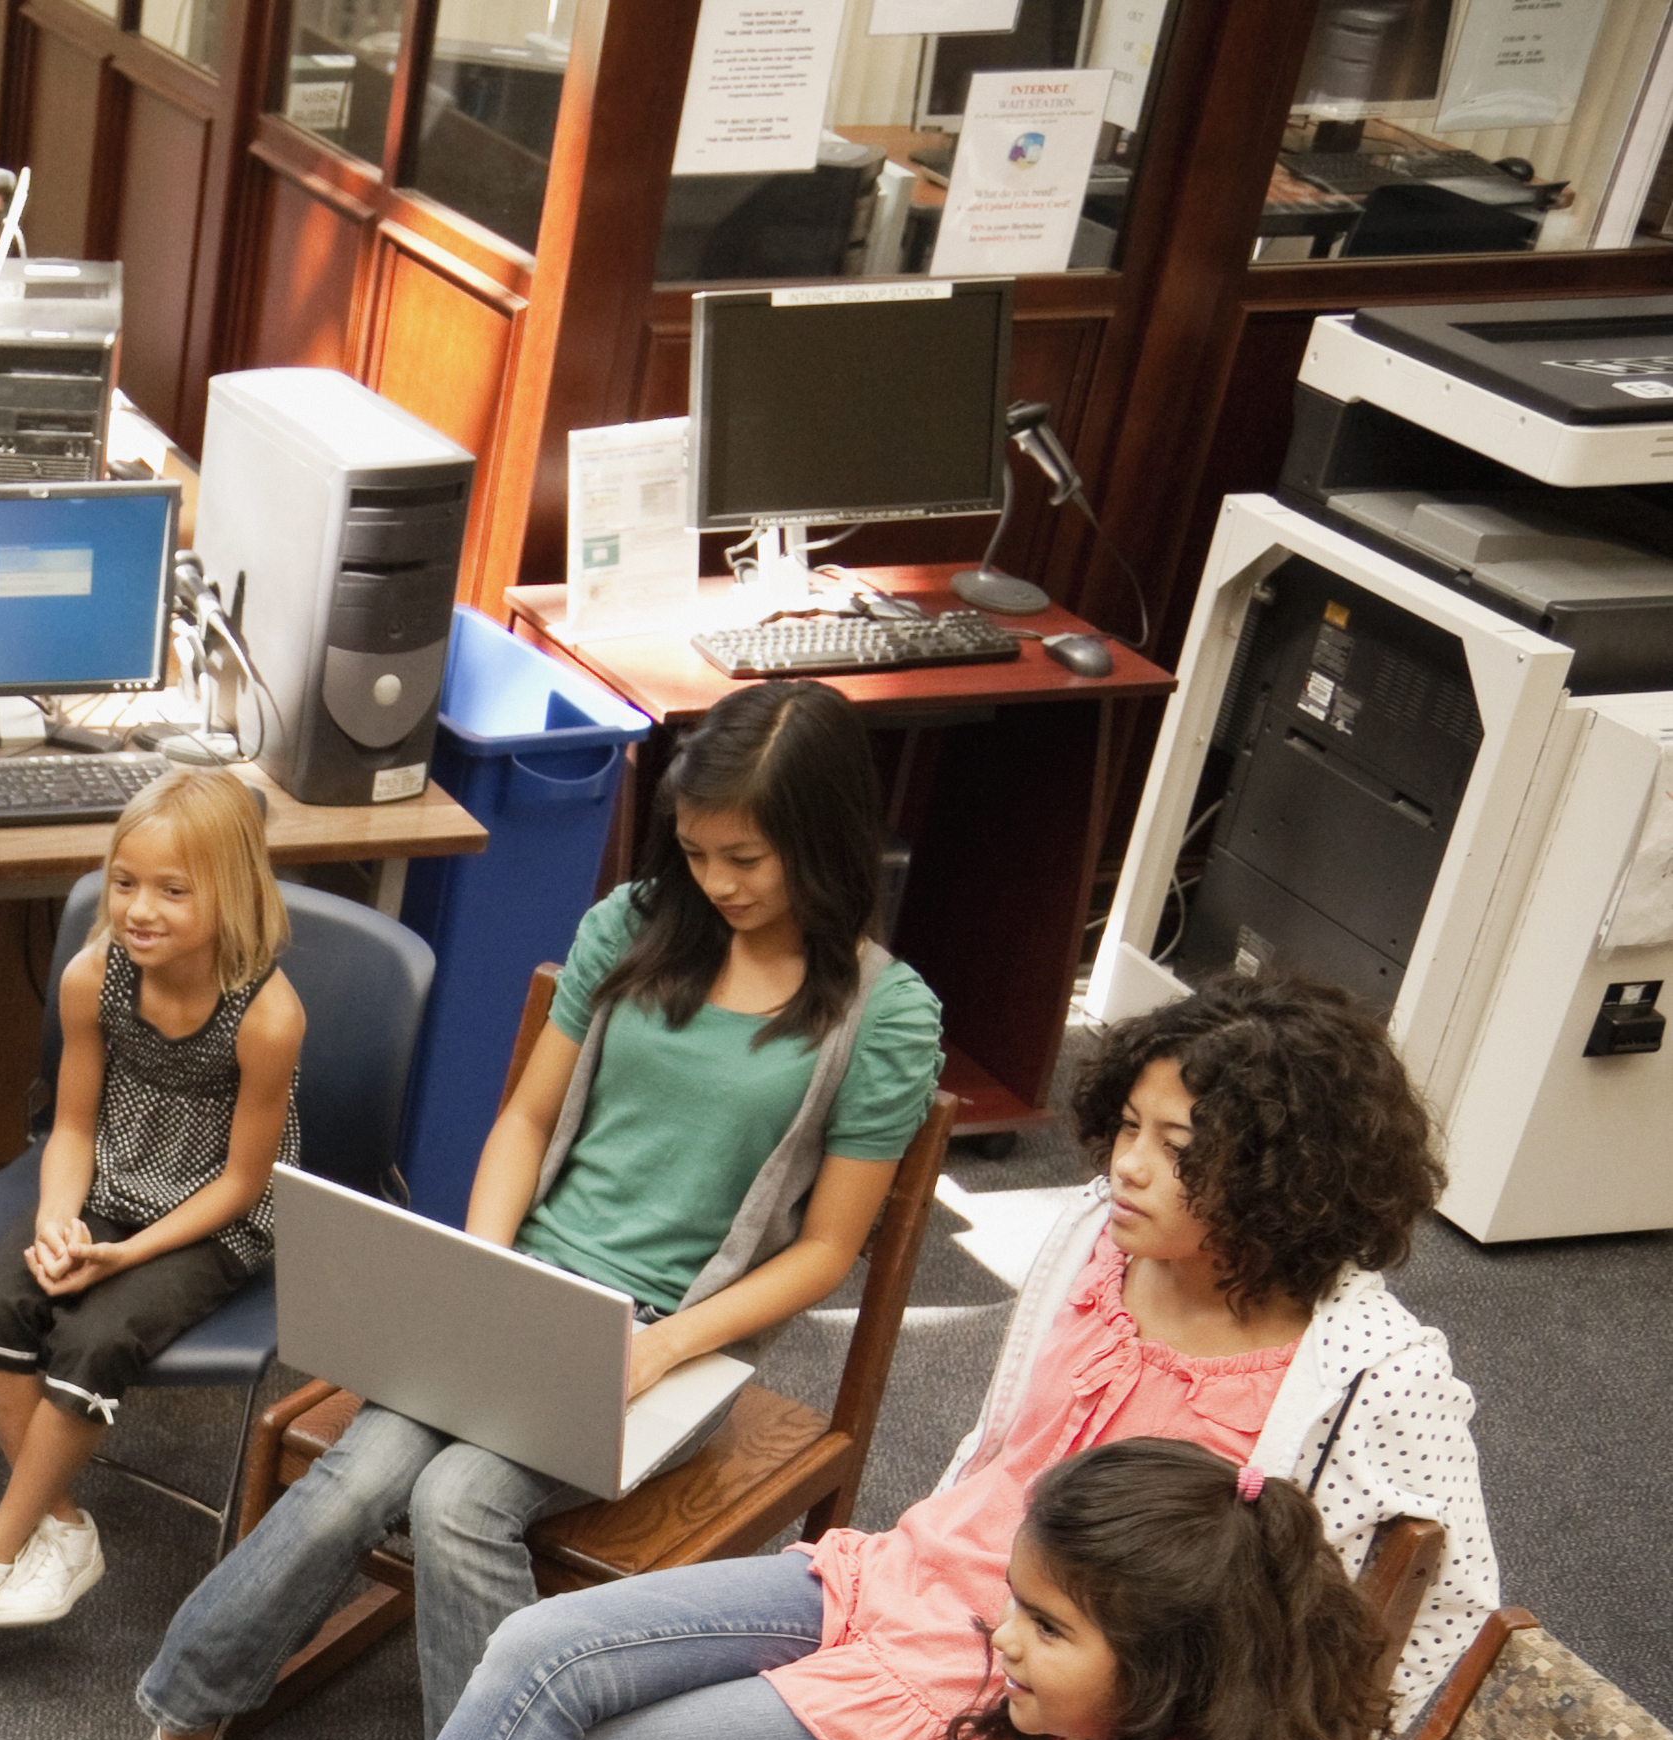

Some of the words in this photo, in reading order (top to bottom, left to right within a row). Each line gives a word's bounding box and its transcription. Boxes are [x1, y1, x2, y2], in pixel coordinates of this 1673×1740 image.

[1010, 83, 1069, 95] INTERNET
[998, 99, 1026, 110] WAIT
[1027, 97, 1075, 109] STATION
[790, 290, 840, 304] INTERNET
[845, 288, 869, 301] SIGN
[871, 288, 887, 300] UP
[889, 286, 934, 300] STATION
